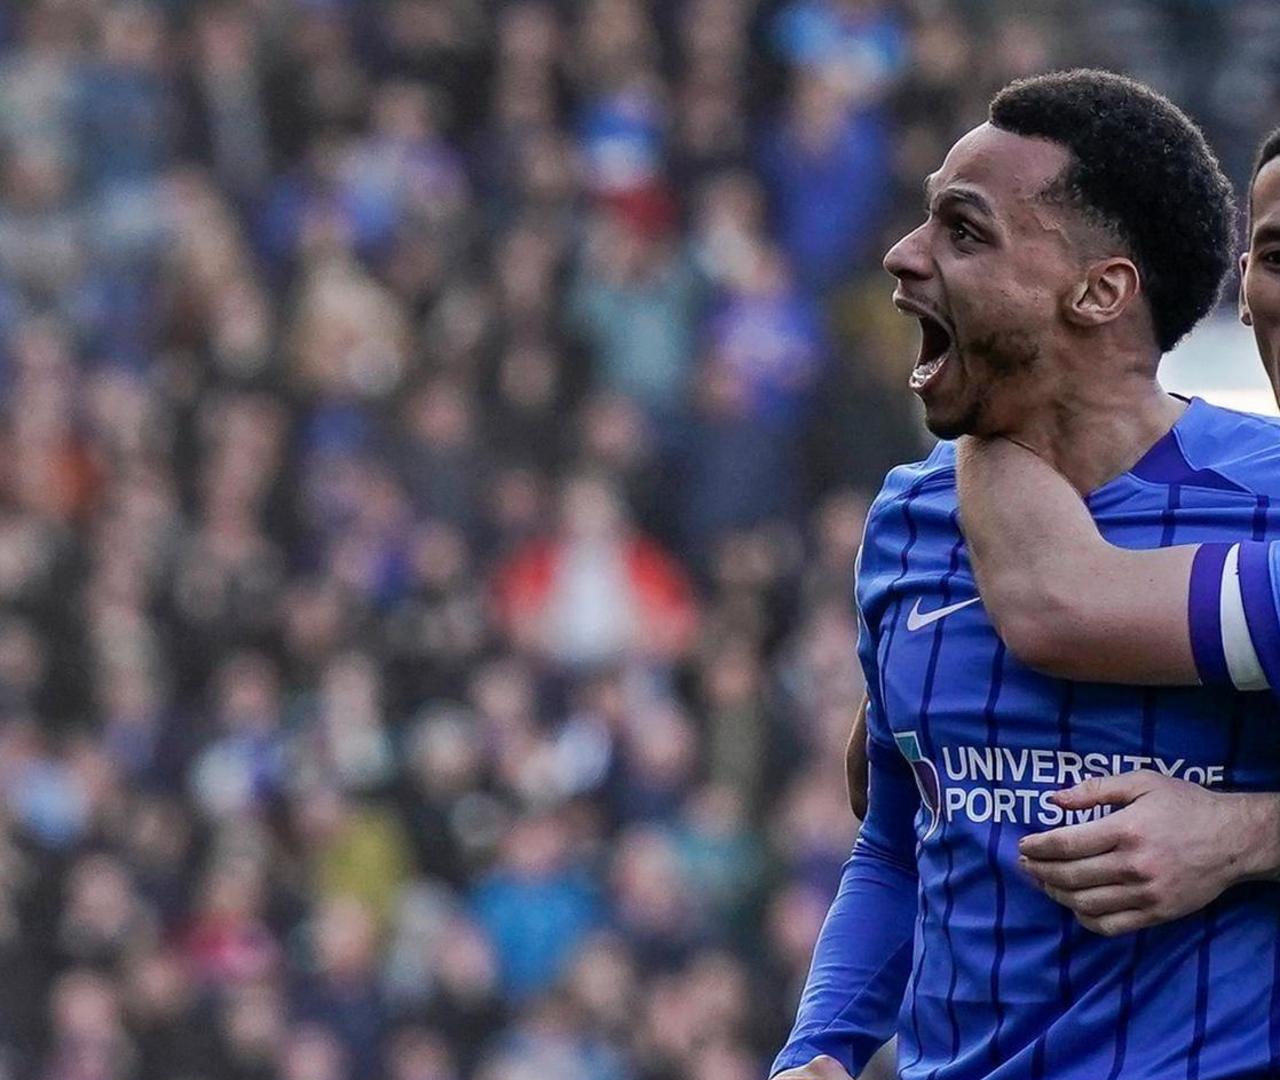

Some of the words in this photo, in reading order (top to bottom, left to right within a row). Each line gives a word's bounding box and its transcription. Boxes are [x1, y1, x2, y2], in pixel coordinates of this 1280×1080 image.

[942, 746, 1185, 784] UNIVERSITY
[1183, 765, 1225, 786] OF
[944, 787, 1112, 826] PORTS
